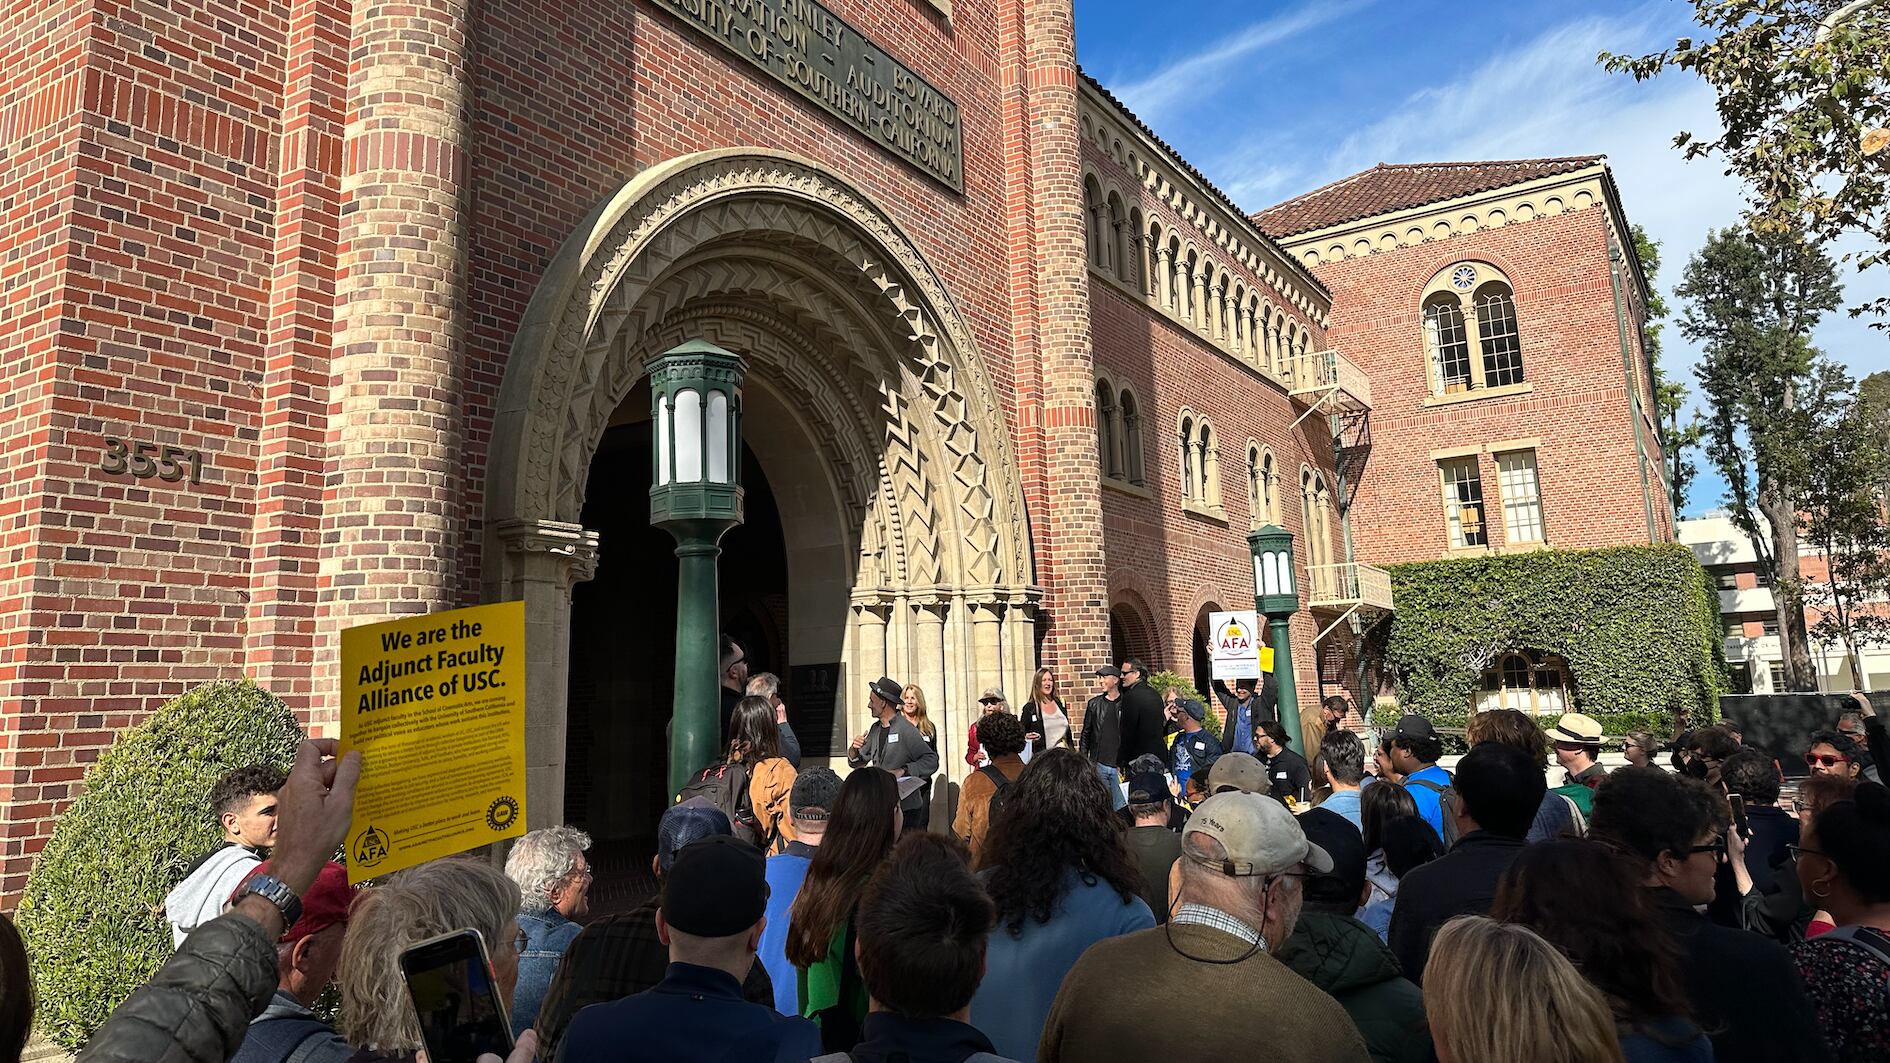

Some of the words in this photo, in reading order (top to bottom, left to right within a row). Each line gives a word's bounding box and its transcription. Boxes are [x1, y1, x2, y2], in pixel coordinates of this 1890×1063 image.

[729, 0, 807, 54] ATION
[846, 64, 956, 156] AUDITORIUM
[893, 66, 955, 126] BOVARD
[747, 29, 775, 61] OF
[786, 53, 870, 132] SOUTHERN
[879, 116, 957, 185] CALIFORNIA
[102, 436, 201, 485] 3551
[381, 631, 412, 652] We
[416, 627, 446, 646] are
[451, 619, 482, 640] the
[1221, 638, 1249, 649] AFA
[358, 654, 433, 686] Adjunct
[438, 643, 505, 670] Faculty
[358, 683, 434, 715] Alliance
[439, 673, 459, 697] of
[463, 669, 506, 693] USC.
[358, 845, 387, 864] AFA
